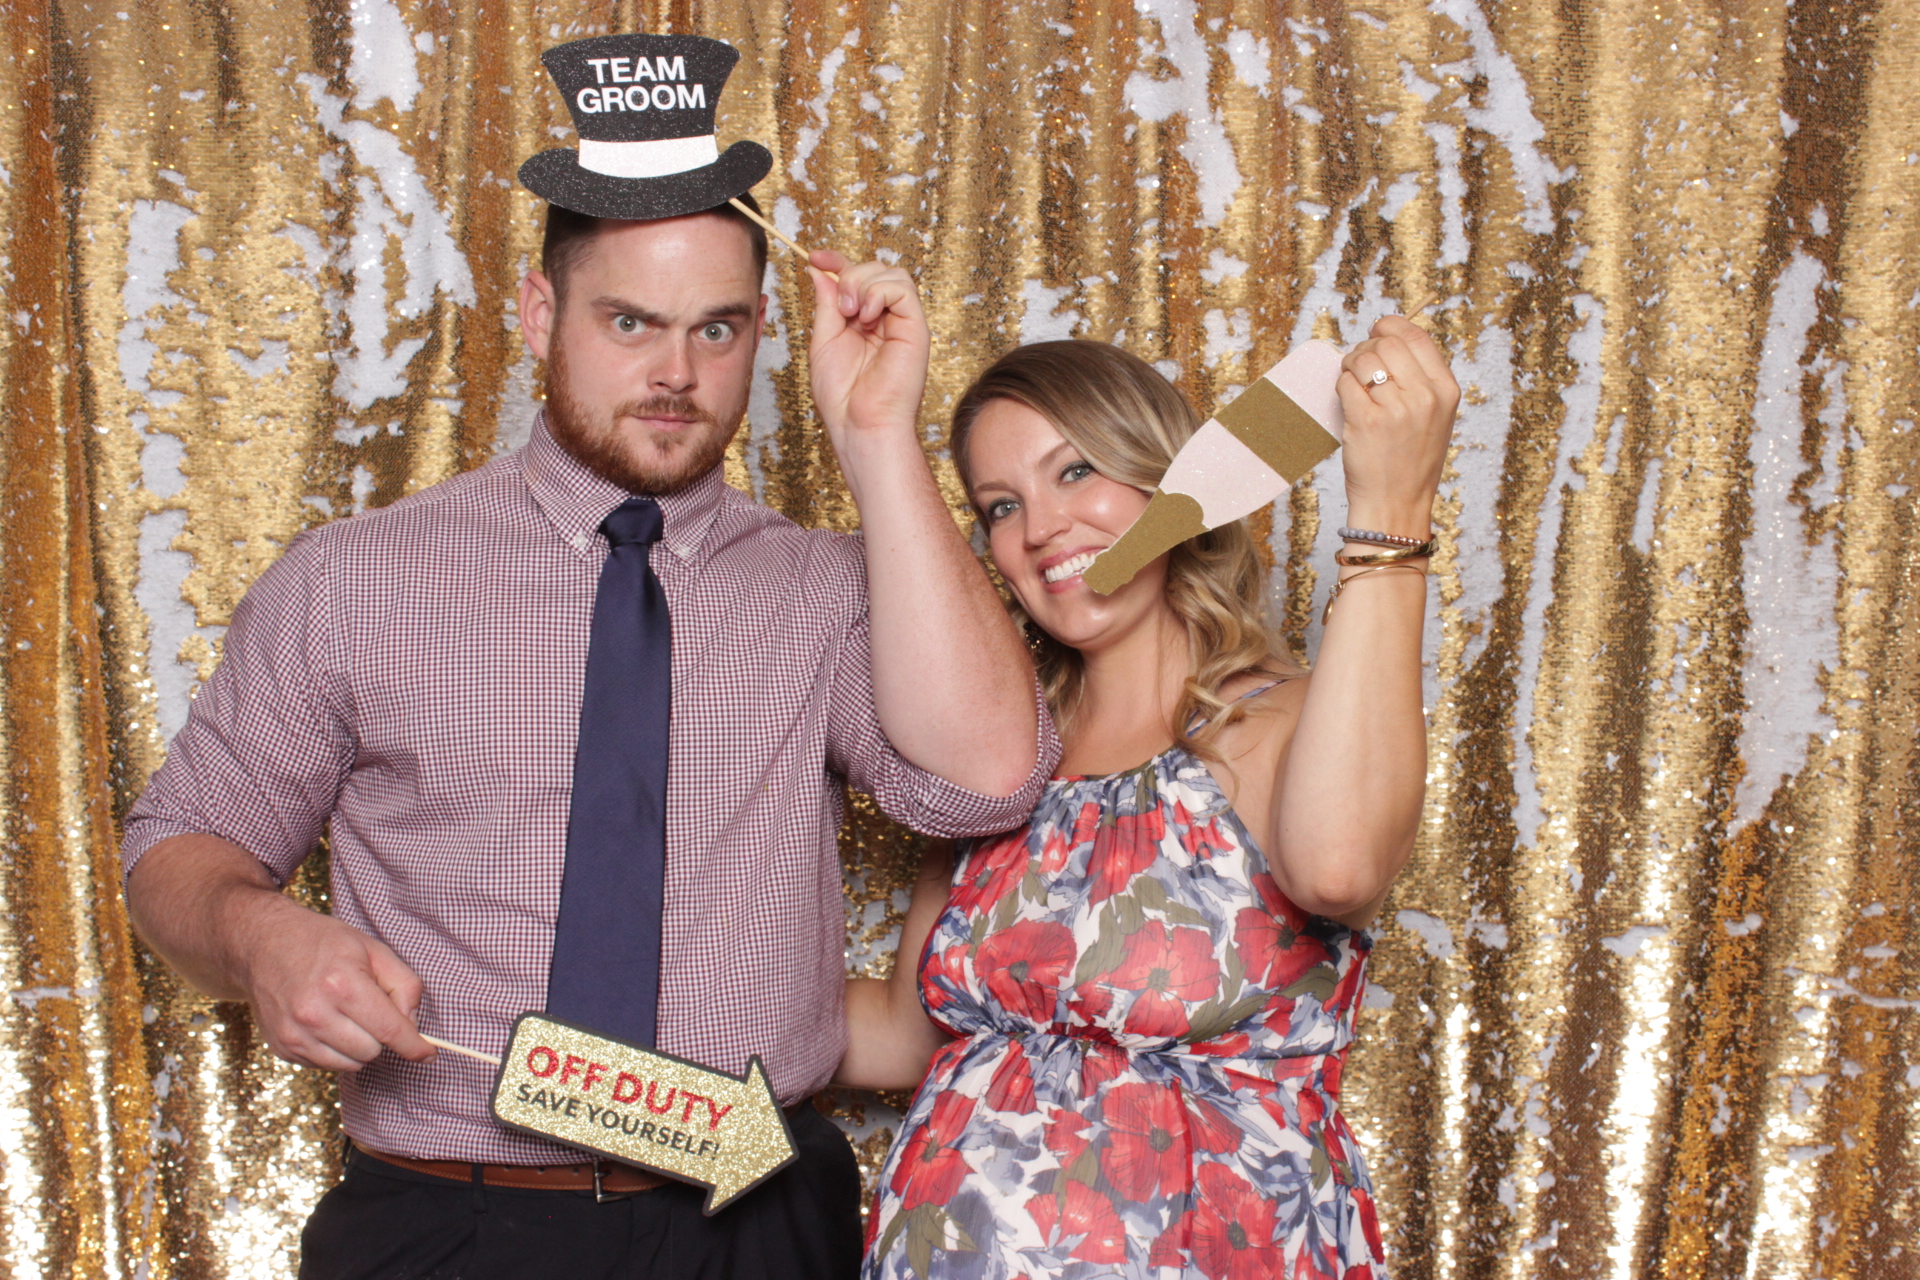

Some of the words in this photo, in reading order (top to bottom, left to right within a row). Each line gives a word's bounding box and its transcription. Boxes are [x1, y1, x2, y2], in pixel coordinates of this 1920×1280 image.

[588, 56, 686, 84] TEAM
[577, 84, 706, 114] GROOM
[527, 1046, 608, 1091] OFF
[611, 1071, 732, 1131] DUTY
[516, 1083, 581, 1118] SAVE
[587, 1103, 721, 1161] YOURSELF!
